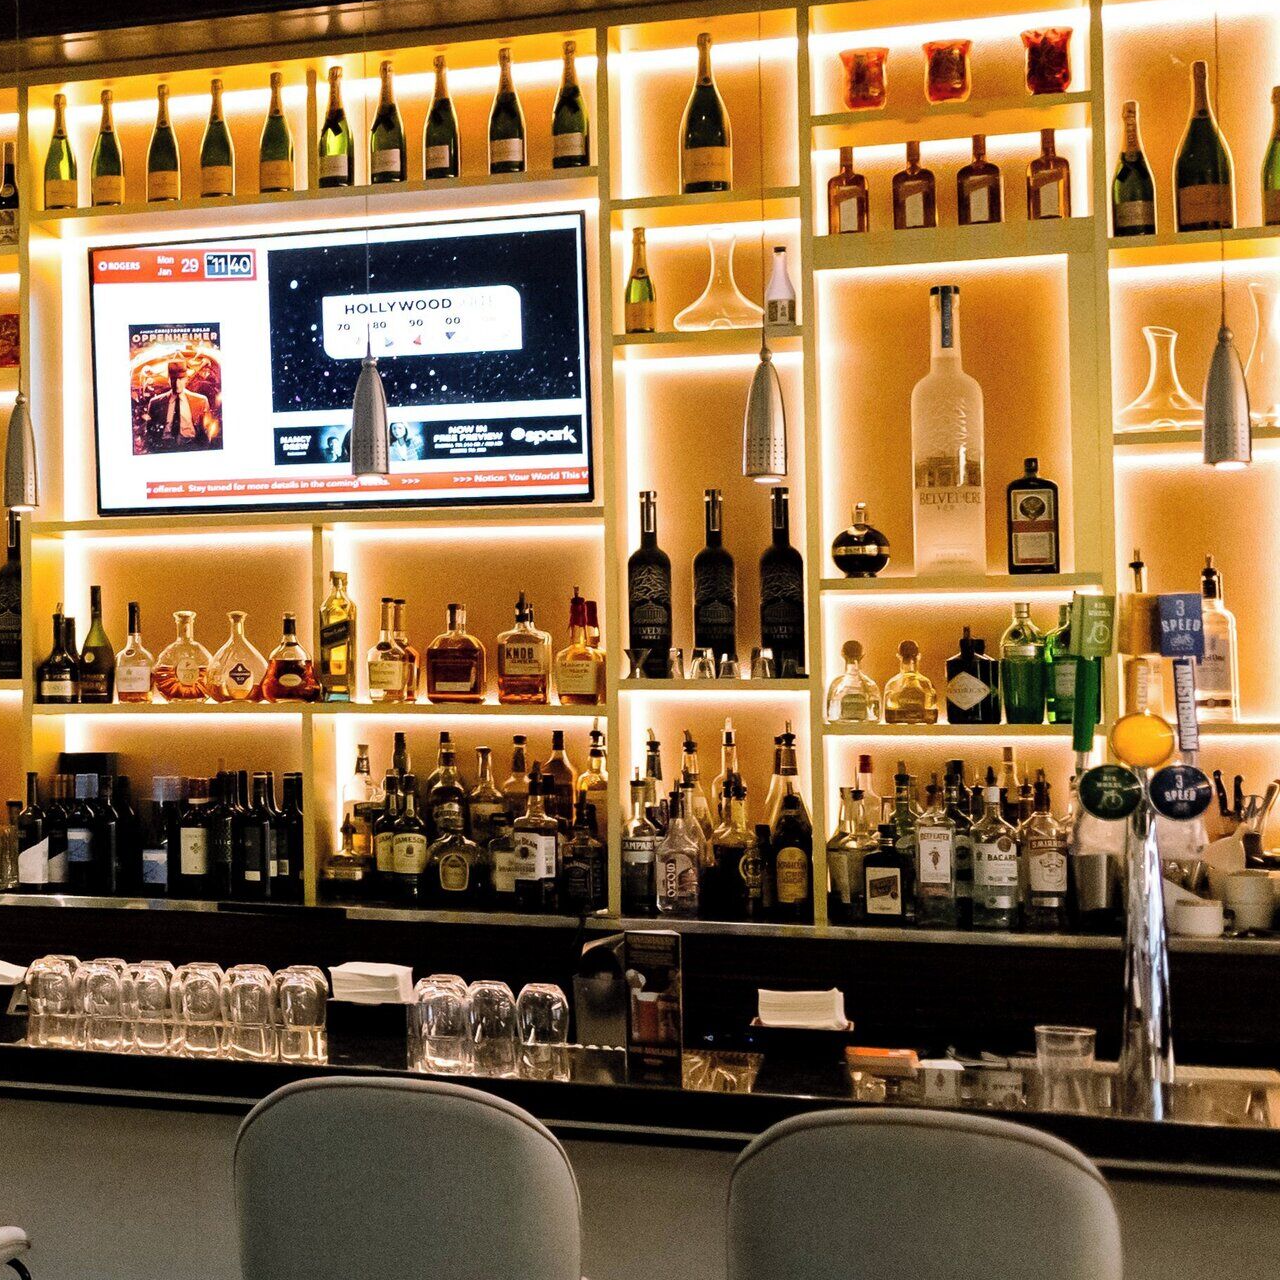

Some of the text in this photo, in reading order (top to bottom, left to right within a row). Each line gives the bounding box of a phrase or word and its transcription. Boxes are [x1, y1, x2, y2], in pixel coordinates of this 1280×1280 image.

[108, 261, 140, 270] ROGERS
[157, 256, 174, 264] Mon
[181, 258, 199, 272] 29
[230, 257, 251, 272] 40
[158, 268, 172, 276] Jan
[344, 298, 452, 315] HOLLYWOOD
[372, 321, 387, 329] 80
[409, 319, 424, 327] 90
[445, 317, 461, 325] 00
[132, 332, 218, 342] OPPENHEIMER
[448, 425, 474, 434] NOW
[525, 425, 577, 445] spark
[474, 474, 507, 482] Notice:
[509, 473, 529, 481] Your
[531, 472, 559, 480] World
[562, 471, 580, 479] This
[153, 485, 184, 494] offered.
[188, 484, 207, 493] Stay
[207, 483, 232, 491] tuned
[271, 481, 299, 489] details
[310, 480, 324, 488] the
[326, 479, 359, 488] coming
[1176, 599, 1185, 617] 3
[1161, 620, 1202, 632] SPEED
[505, 646, 534, 661] KNOB
[1175, 775, 1183, 788] 3
[1164, 787, 1197, 801] SPEED
